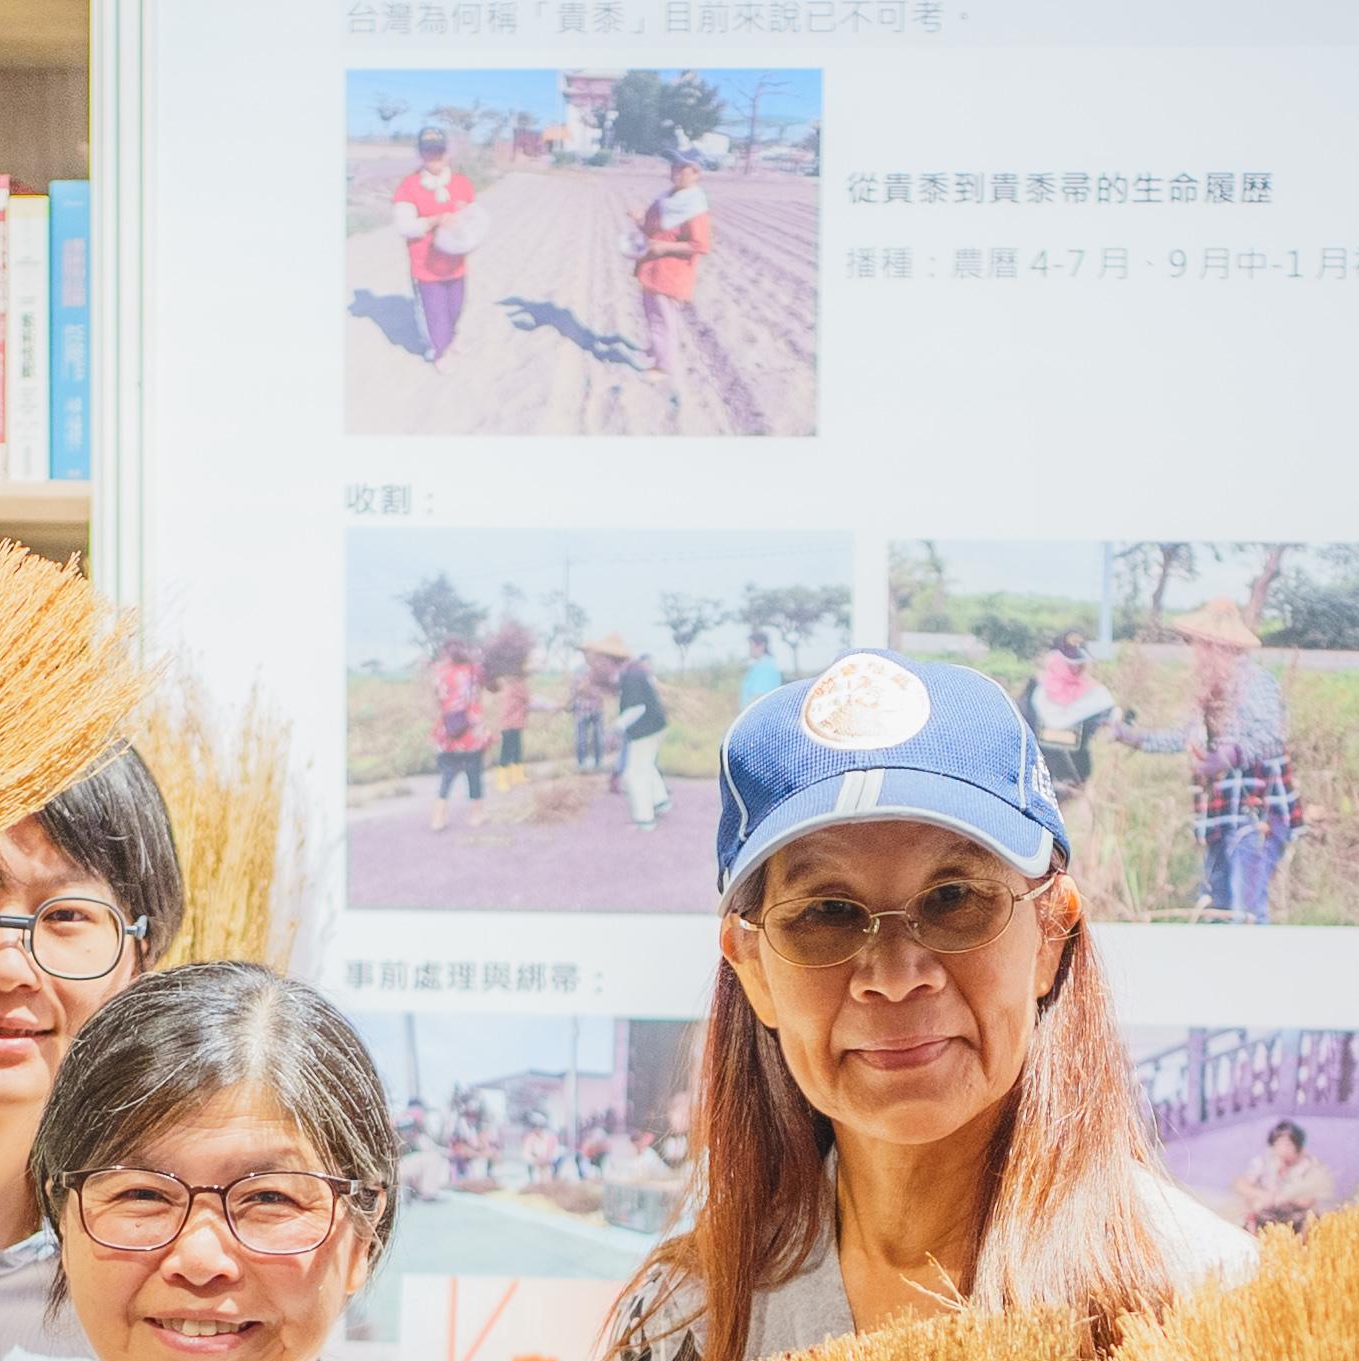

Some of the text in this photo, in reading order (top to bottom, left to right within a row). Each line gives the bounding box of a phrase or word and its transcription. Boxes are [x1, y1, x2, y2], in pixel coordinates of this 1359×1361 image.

[848, 172, 1273, 205] 從貴黍到貴黍帚的生命履歷
